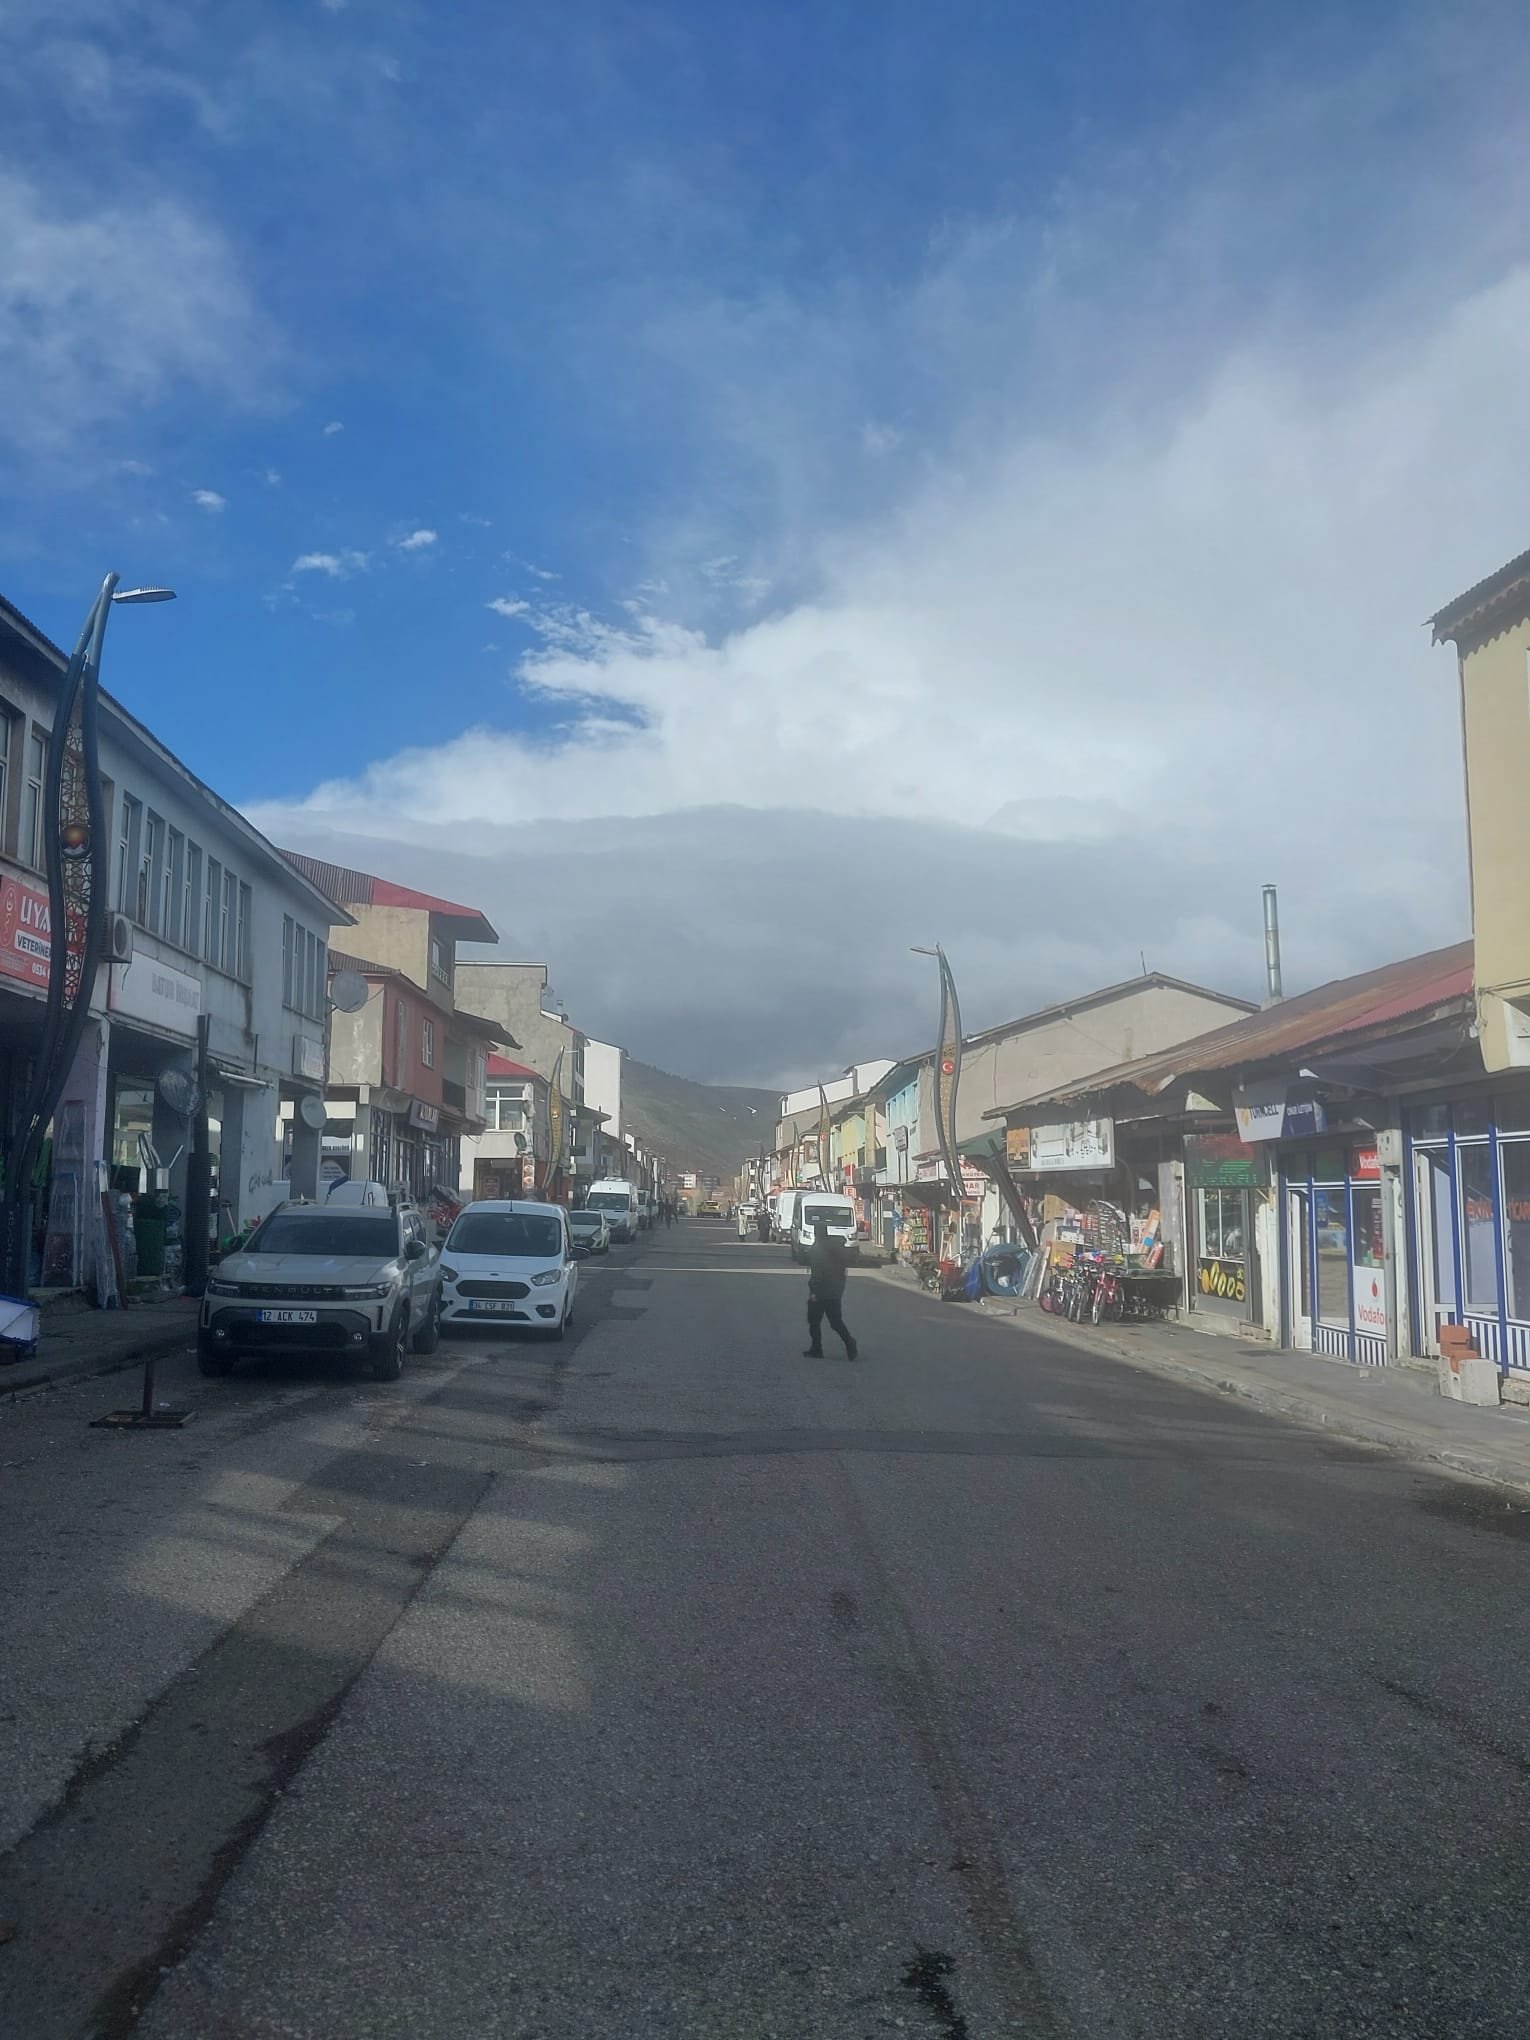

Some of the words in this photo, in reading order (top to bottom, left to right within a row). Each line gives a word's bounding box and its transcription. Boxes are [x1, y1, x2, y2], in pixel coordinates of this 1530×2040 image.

[17, 934, 51, 958] VETERİNE
[277, 1311, 293, 1321] ACK
[299, 1312, 315, 1321] 474
